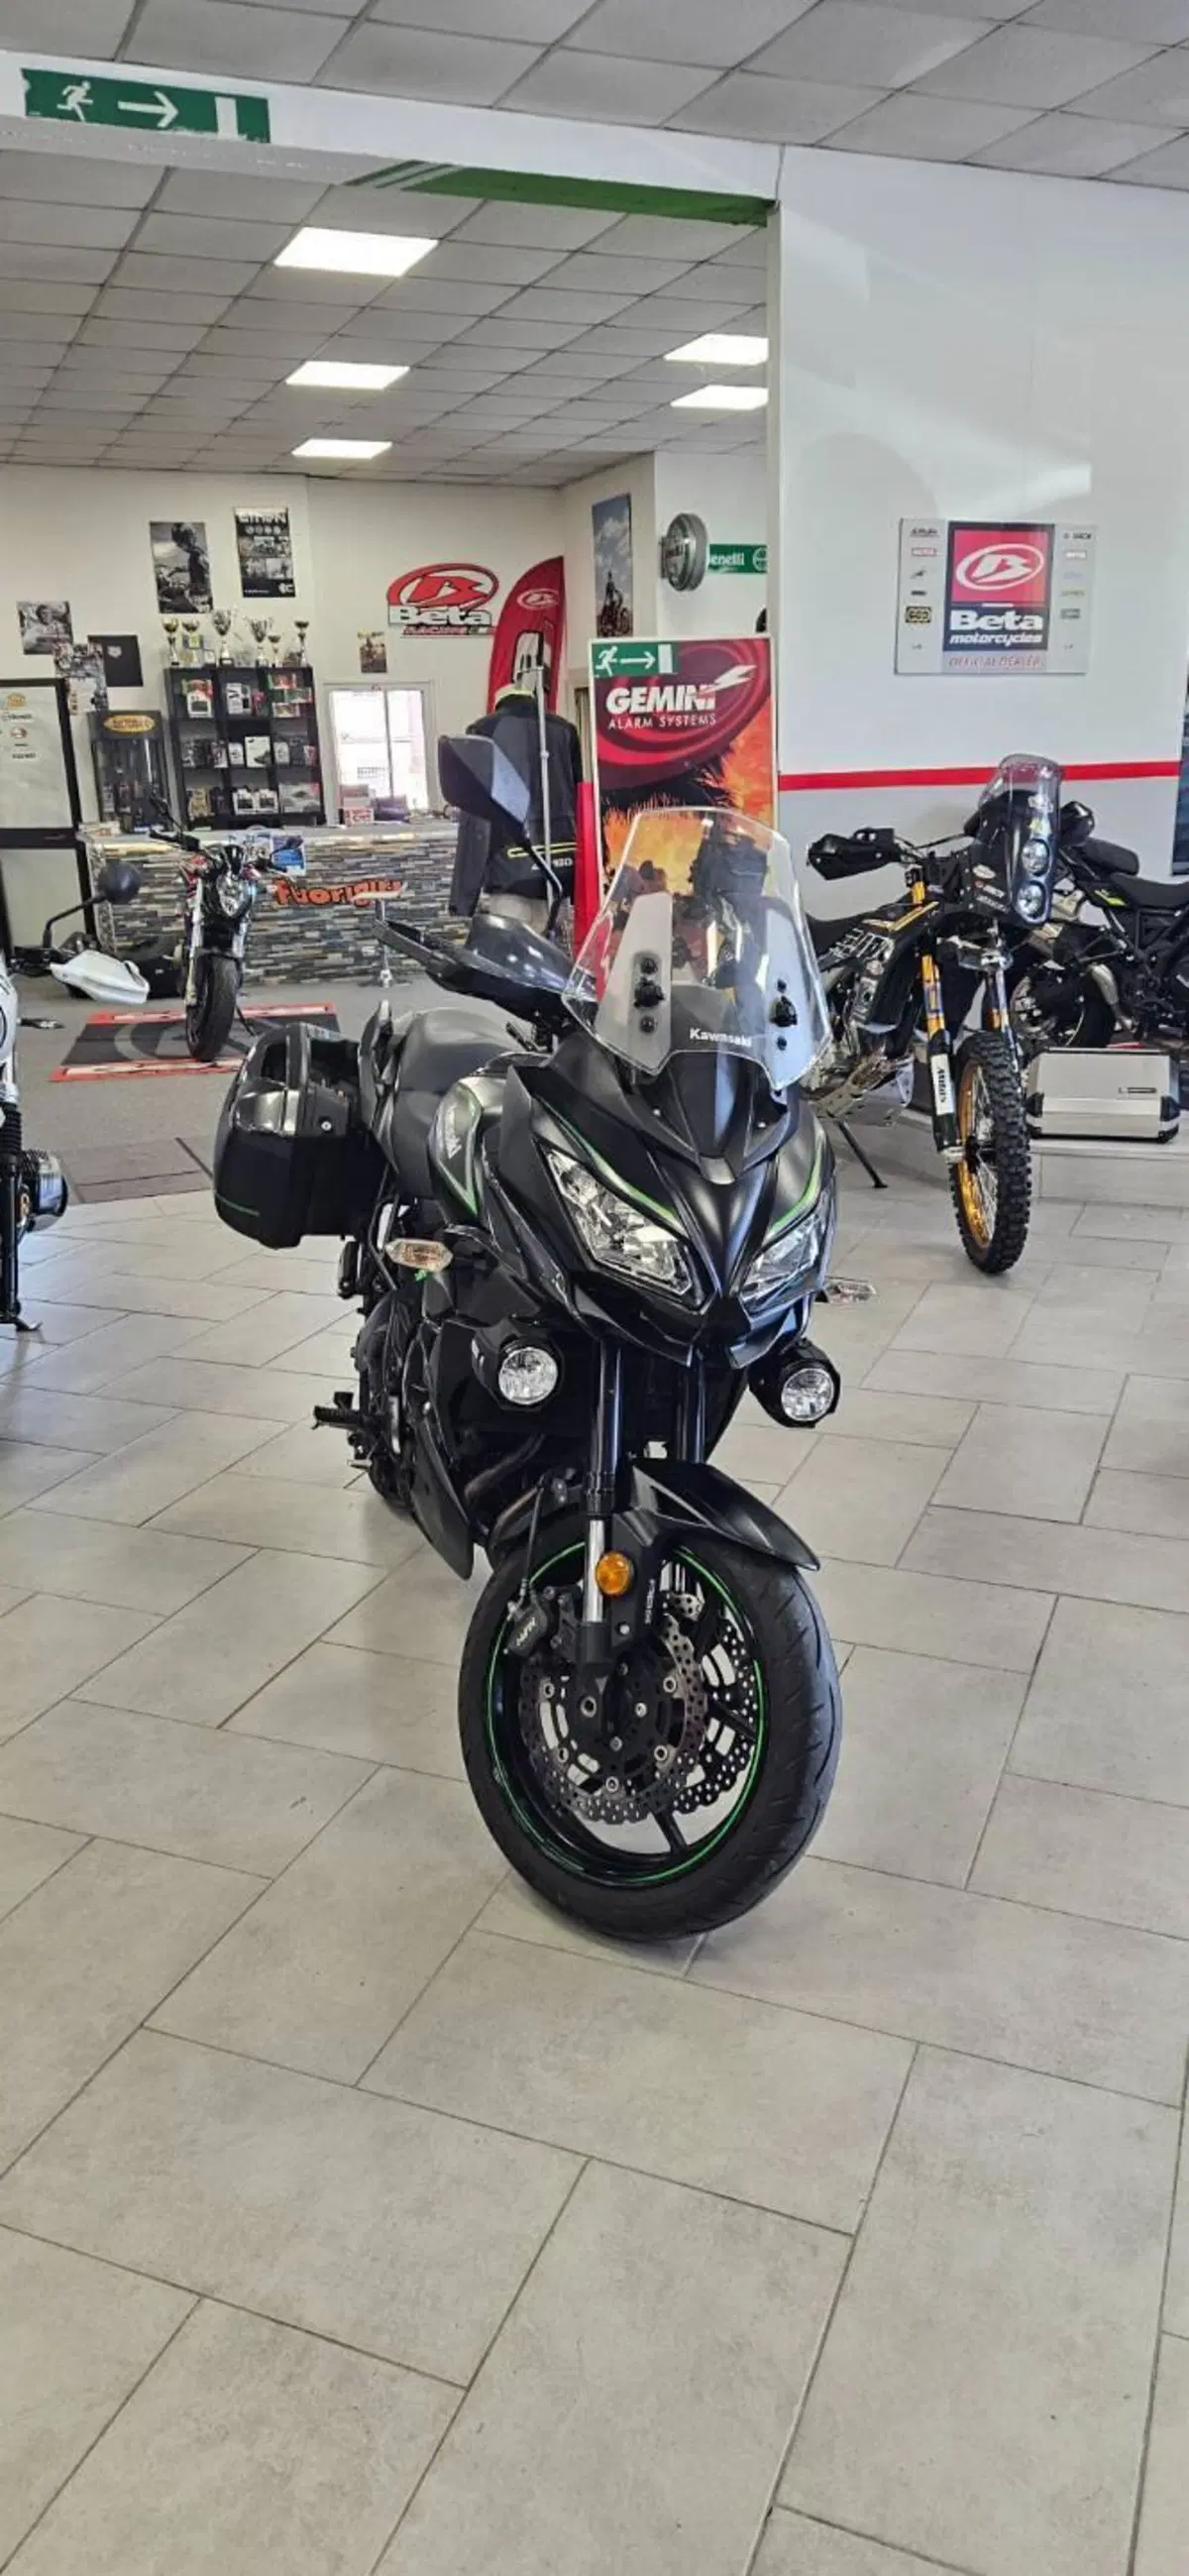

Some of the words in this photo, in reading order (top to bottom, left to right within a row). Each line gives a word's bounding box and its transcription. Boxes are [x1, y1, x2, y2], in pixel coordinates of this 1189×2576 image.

[707, 552, 745, 566] enelli
[387, 604, 492, 624] Beta
[949, 609, 1043, 631] Beta
[948, 631, 1043, 647] motorcycles
[605, 684, 716, 716] GEMINI
[607, 717, 654, 730] ALARM
[658, 713, 717, 728] SYSTEMS
[689, 1027, 753, 1048] Kawasaki
